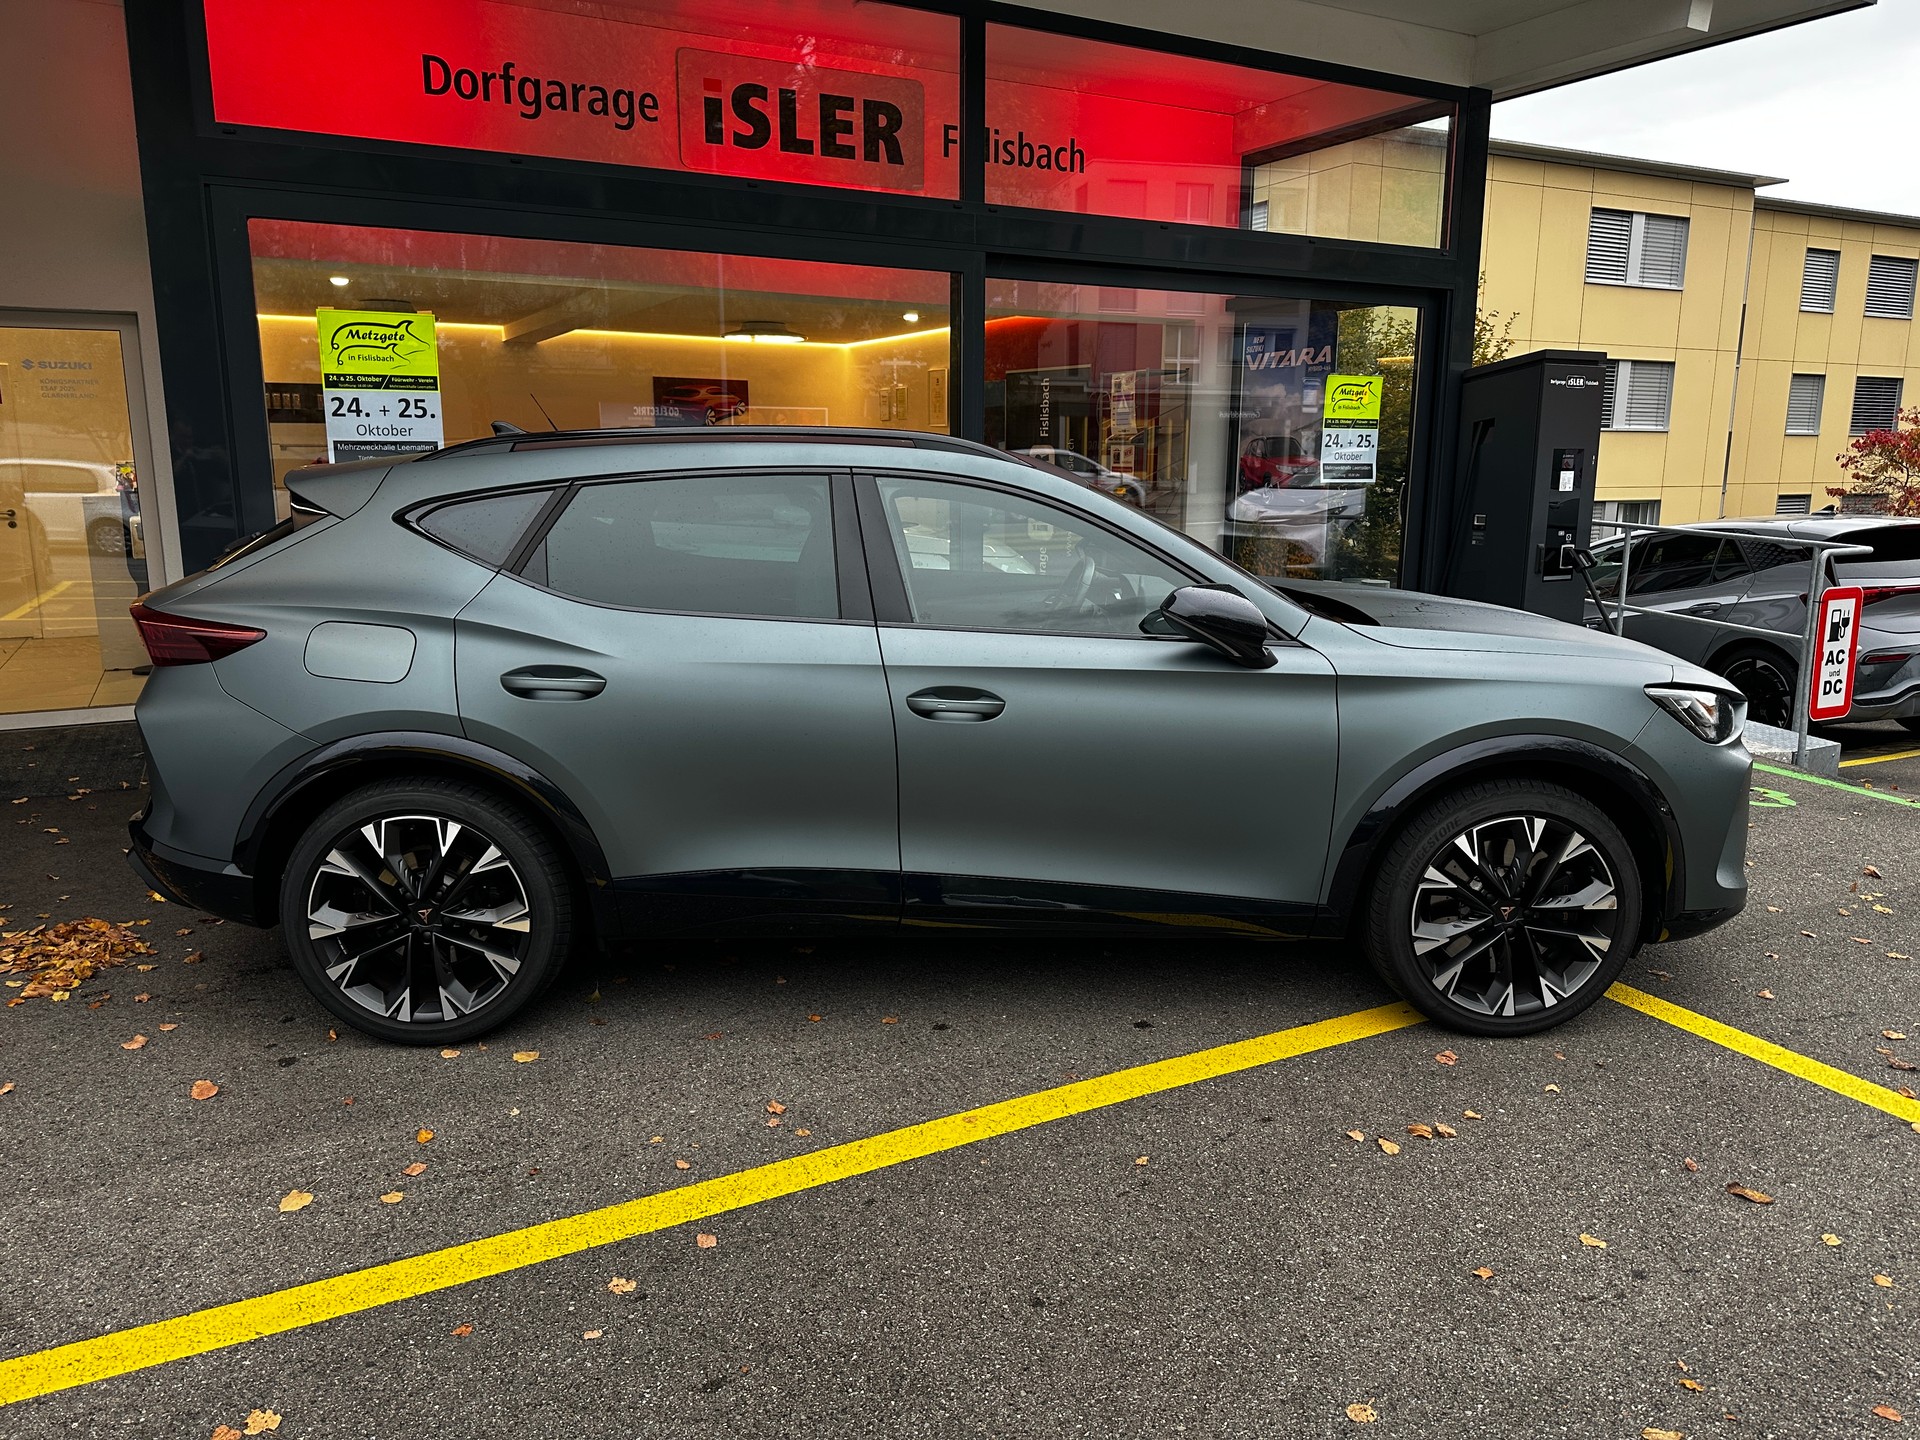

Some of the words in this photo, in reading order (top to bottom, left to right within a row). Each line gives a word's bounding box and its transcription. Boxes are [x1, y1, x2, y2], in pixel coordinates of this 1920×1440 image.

[421, 53, 659, 131] Dorfgarage
[702, 78, 905, 166] iSLER
[943, 123, 1085, 174] Flisbach
[345, 329, 405, 343] Metzgete
[357, 354, 395, 362] Fislisbach
[1246, 345, 1332, 371] VITARA
[37, 361, 93, 370] SUZUKI
[1339, 388, 1367, 397] Metzgete
[330, 396, 371, 418] 24.
[379, 405, 390, 417] +
[398, 398, 436, 419] 25.
[1040, 378, 1050, 437] Fislisbach
[356, 423, 414, 437] Oktober
[337, 443, 395, 451] Mehrzweckhalle
[1324, 433, 1343, 448] 24.
[1347, 439, 1353, 447] +
[1357, 434, 1375, 448] 25.
[1334, 451, 1363, 461] Oktober
[1825, 649, 1846, 667] AC
[1829, 668, 1841, 677] und
[1822, 678, 1843, 696] DC
